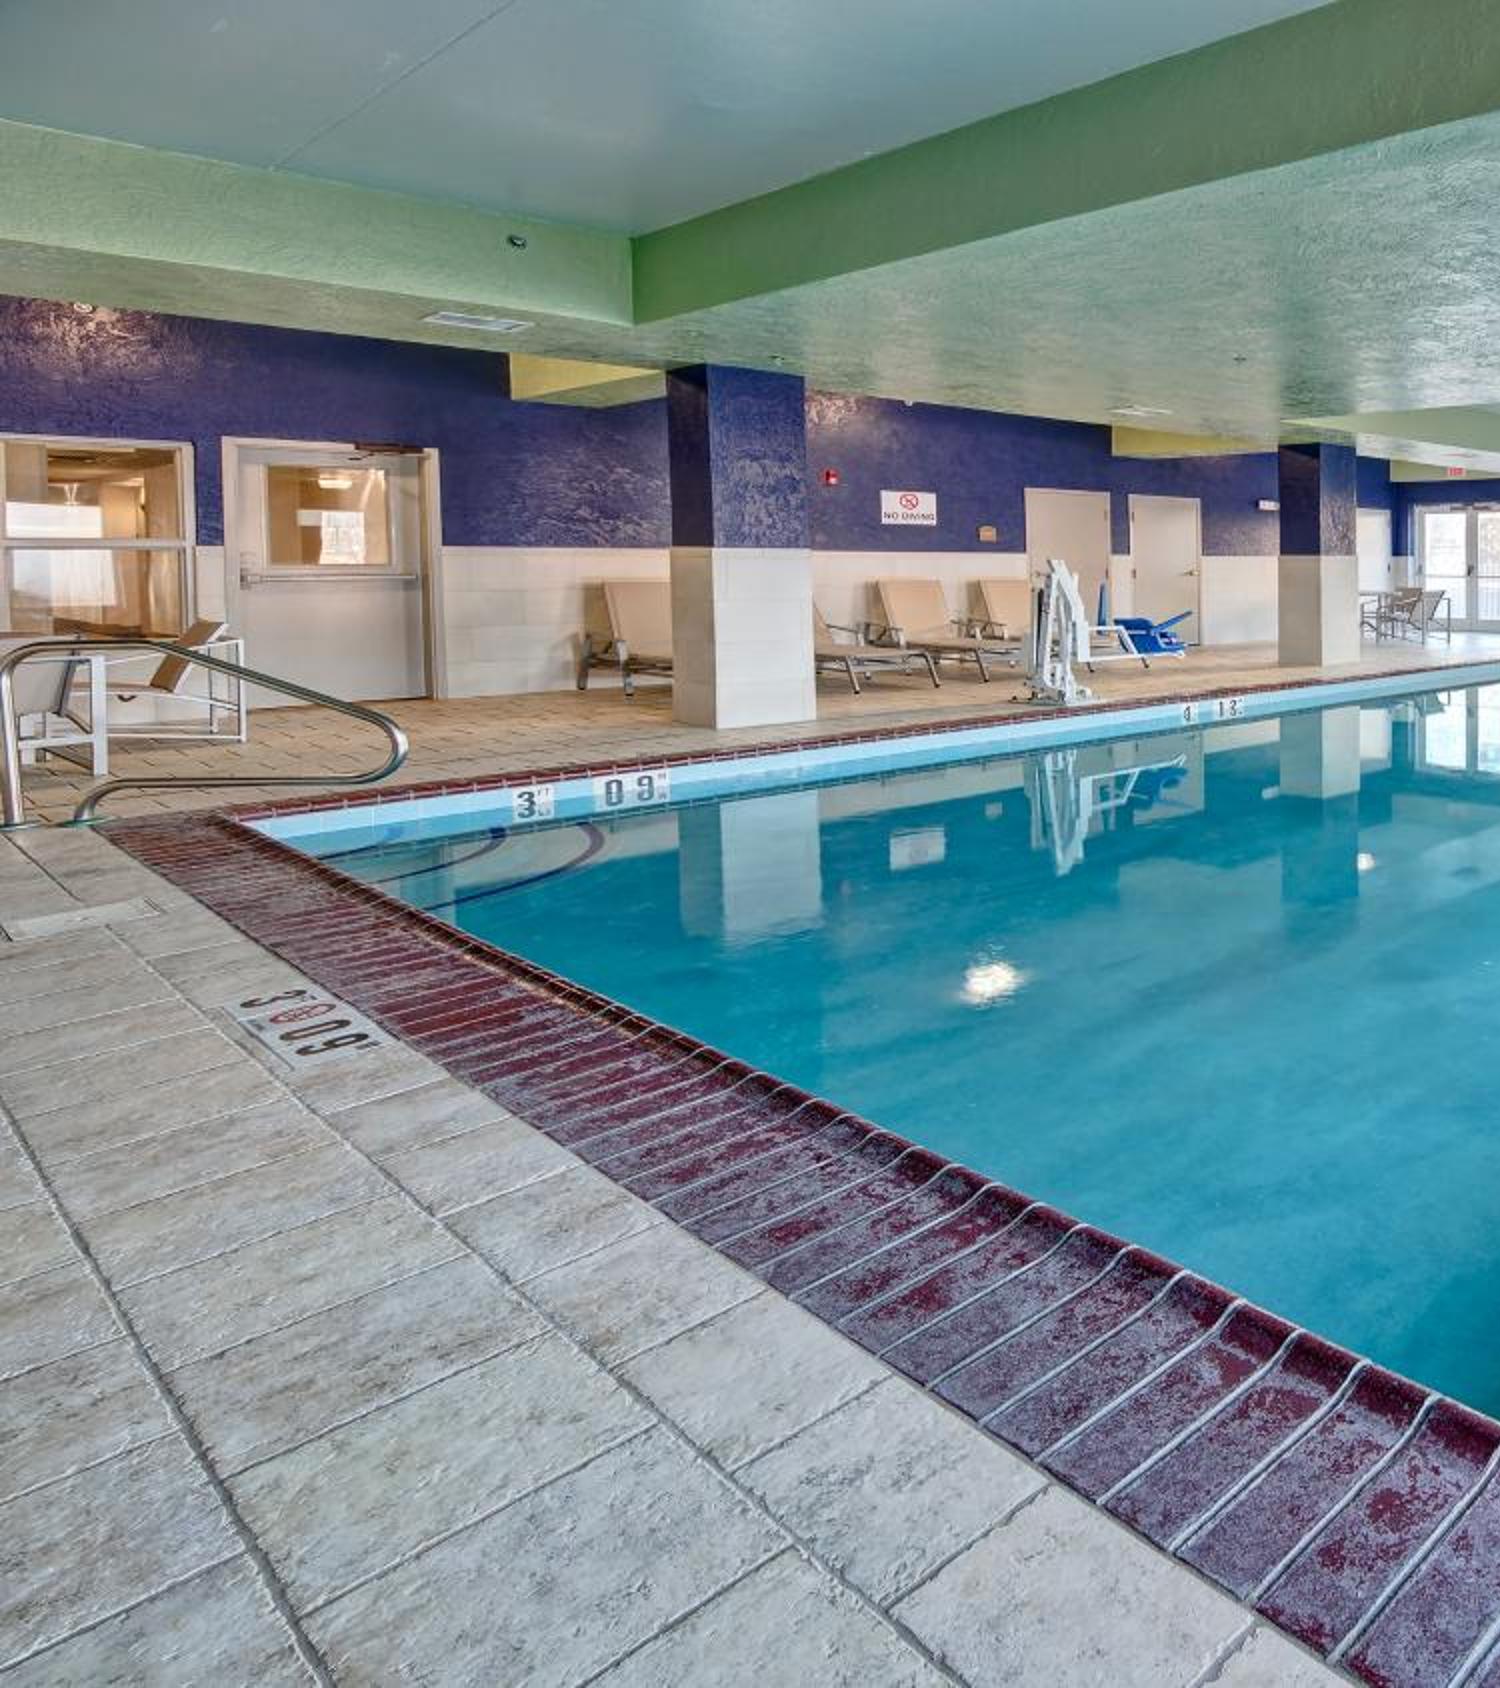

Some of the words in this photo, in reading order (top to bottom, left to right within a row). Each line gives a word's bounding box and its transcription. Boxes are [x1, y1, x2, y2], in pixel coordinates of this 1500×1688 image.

[884, 512, 899, 520] NO
[902, 512, 935, 521] DIVING
[517, 791, 536, 818] 3
[239, 989, 307, 1009] 3
